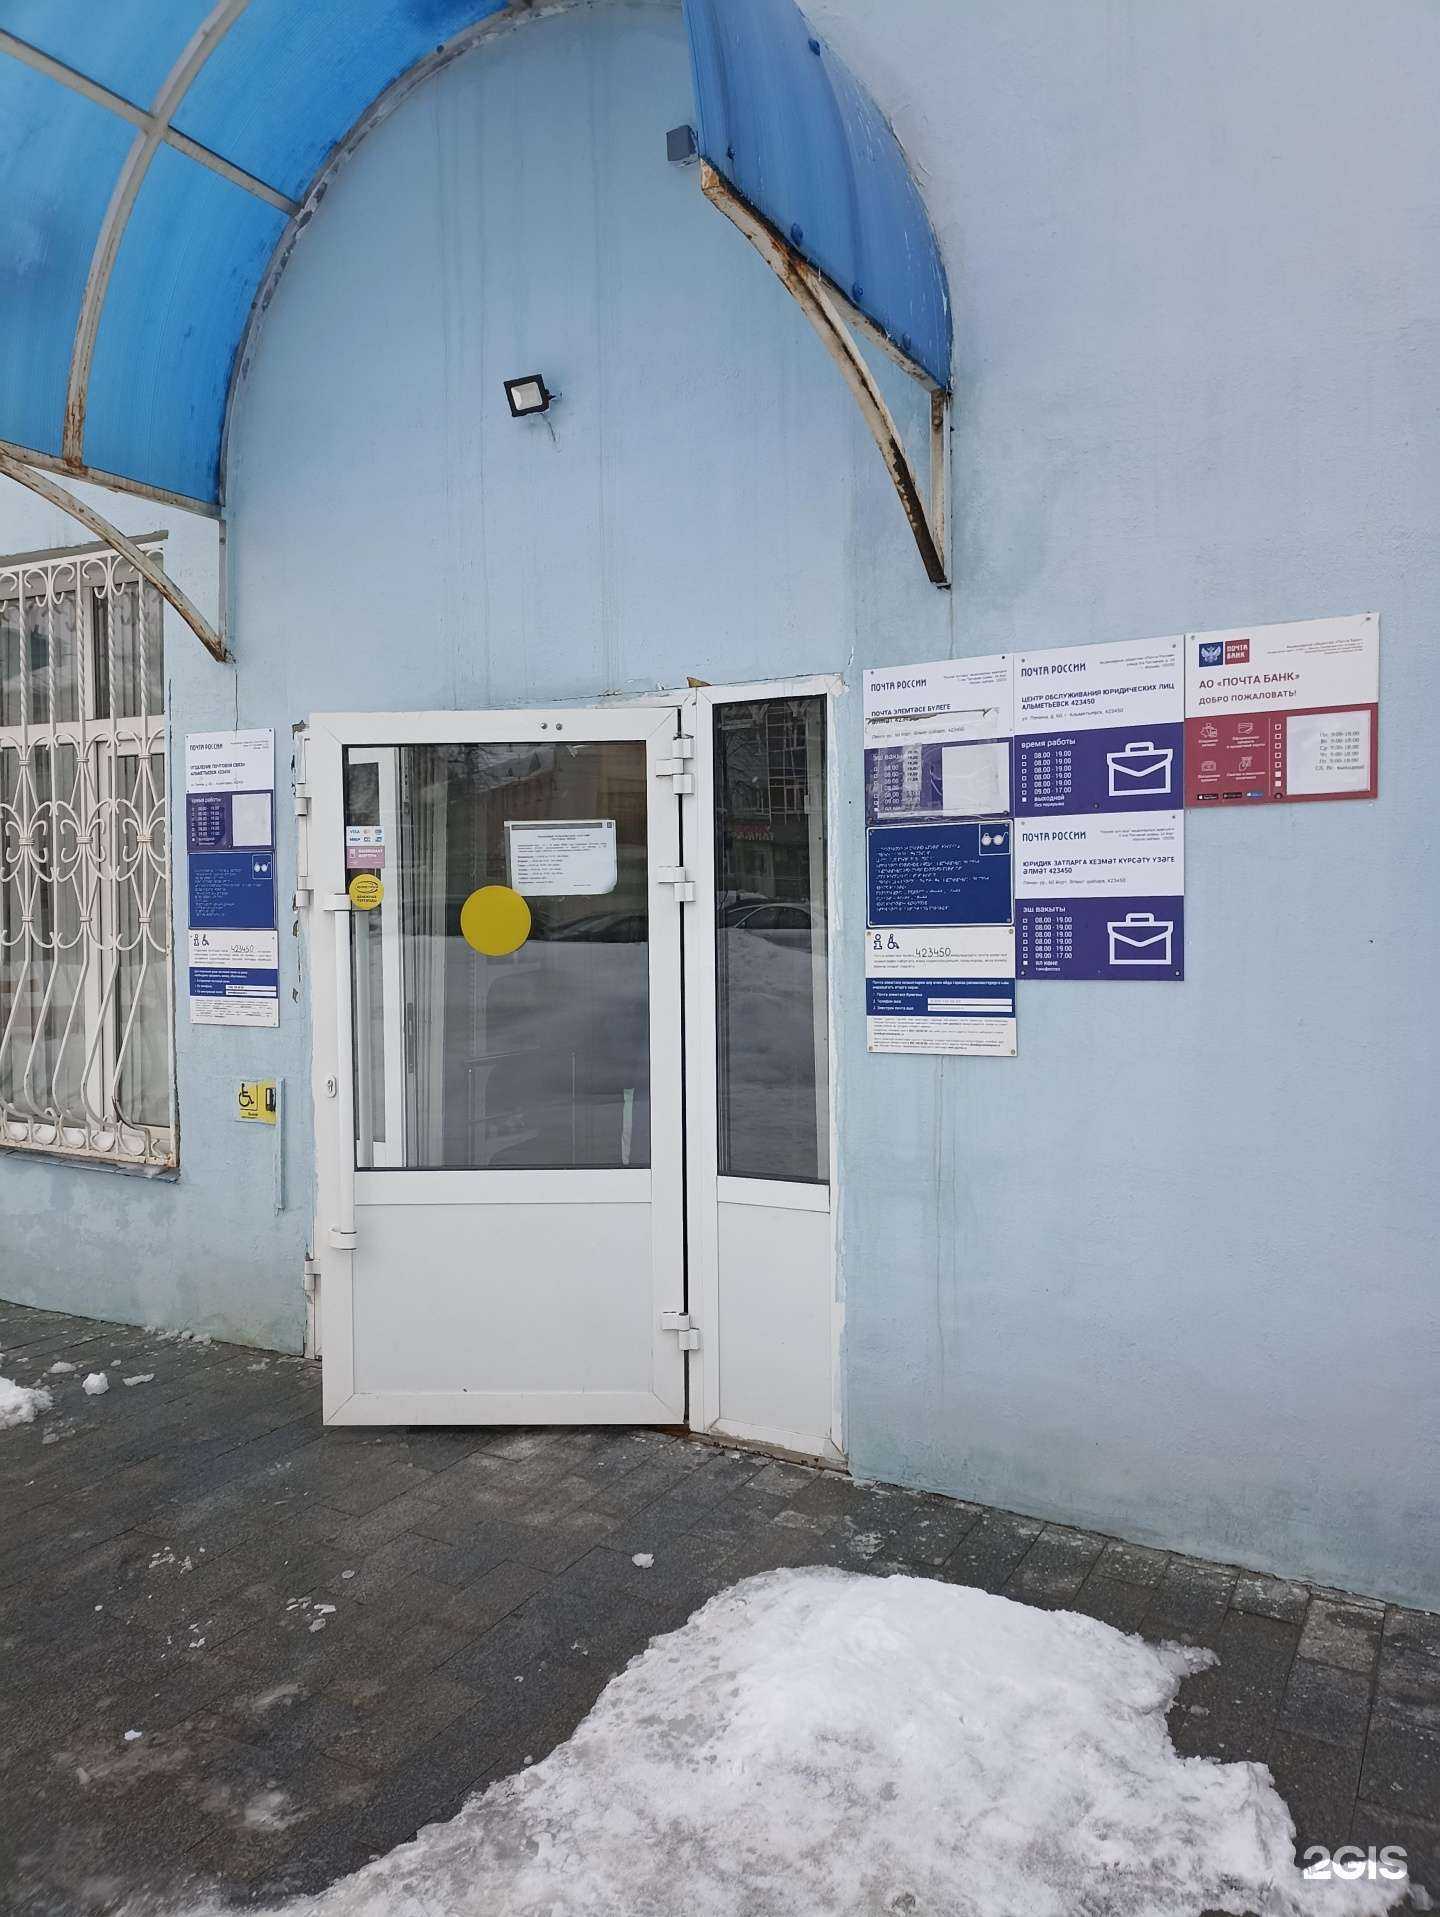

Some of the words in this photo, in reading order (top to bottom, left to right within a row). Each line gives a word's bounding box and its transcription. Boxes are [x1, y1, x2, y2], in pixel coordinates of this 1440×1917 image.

[1226, 644, 1249, 652] ПОЧТА
[1021, 666, 1049, 677] ПОЧТА
[1052, 662, 1086, 674] РОССИИ
[871, 682, 895, 692] ПОЧТА
[897, 679, 927, 690] РОССИИ
[1199, 680, 1214, 689] АО
[1217, 674, 1260, 687] «ПОЧТА
[1264, 672, 1300, 684] БАНК»
[1045, 690, 1102, 700] ОБСЛУЖИВАНИЯ
[1102, 684, 1157, 696] ЮРИДИЧЕСКИХ
[1198, 696, 1228, 706] ДОБРО
[1231, 690, 1297, 702] ПОЖАЛОВАТЬ!
[1022, 701, 1070, 710] АЛЬМЕТЬЕВСК
[1071, 698, 1096, 706] 423450
[1021, 741, 1045, 749] время
[1047, 738, 1076, 747] работы
[1022, 832, 1050, 842] ПОЧТА
[1052, 831, 1087, 841] РОССИИ
[1023, 860, 1052, 868] ЮРИДИК
[915, 947, 951, 958] 423450
